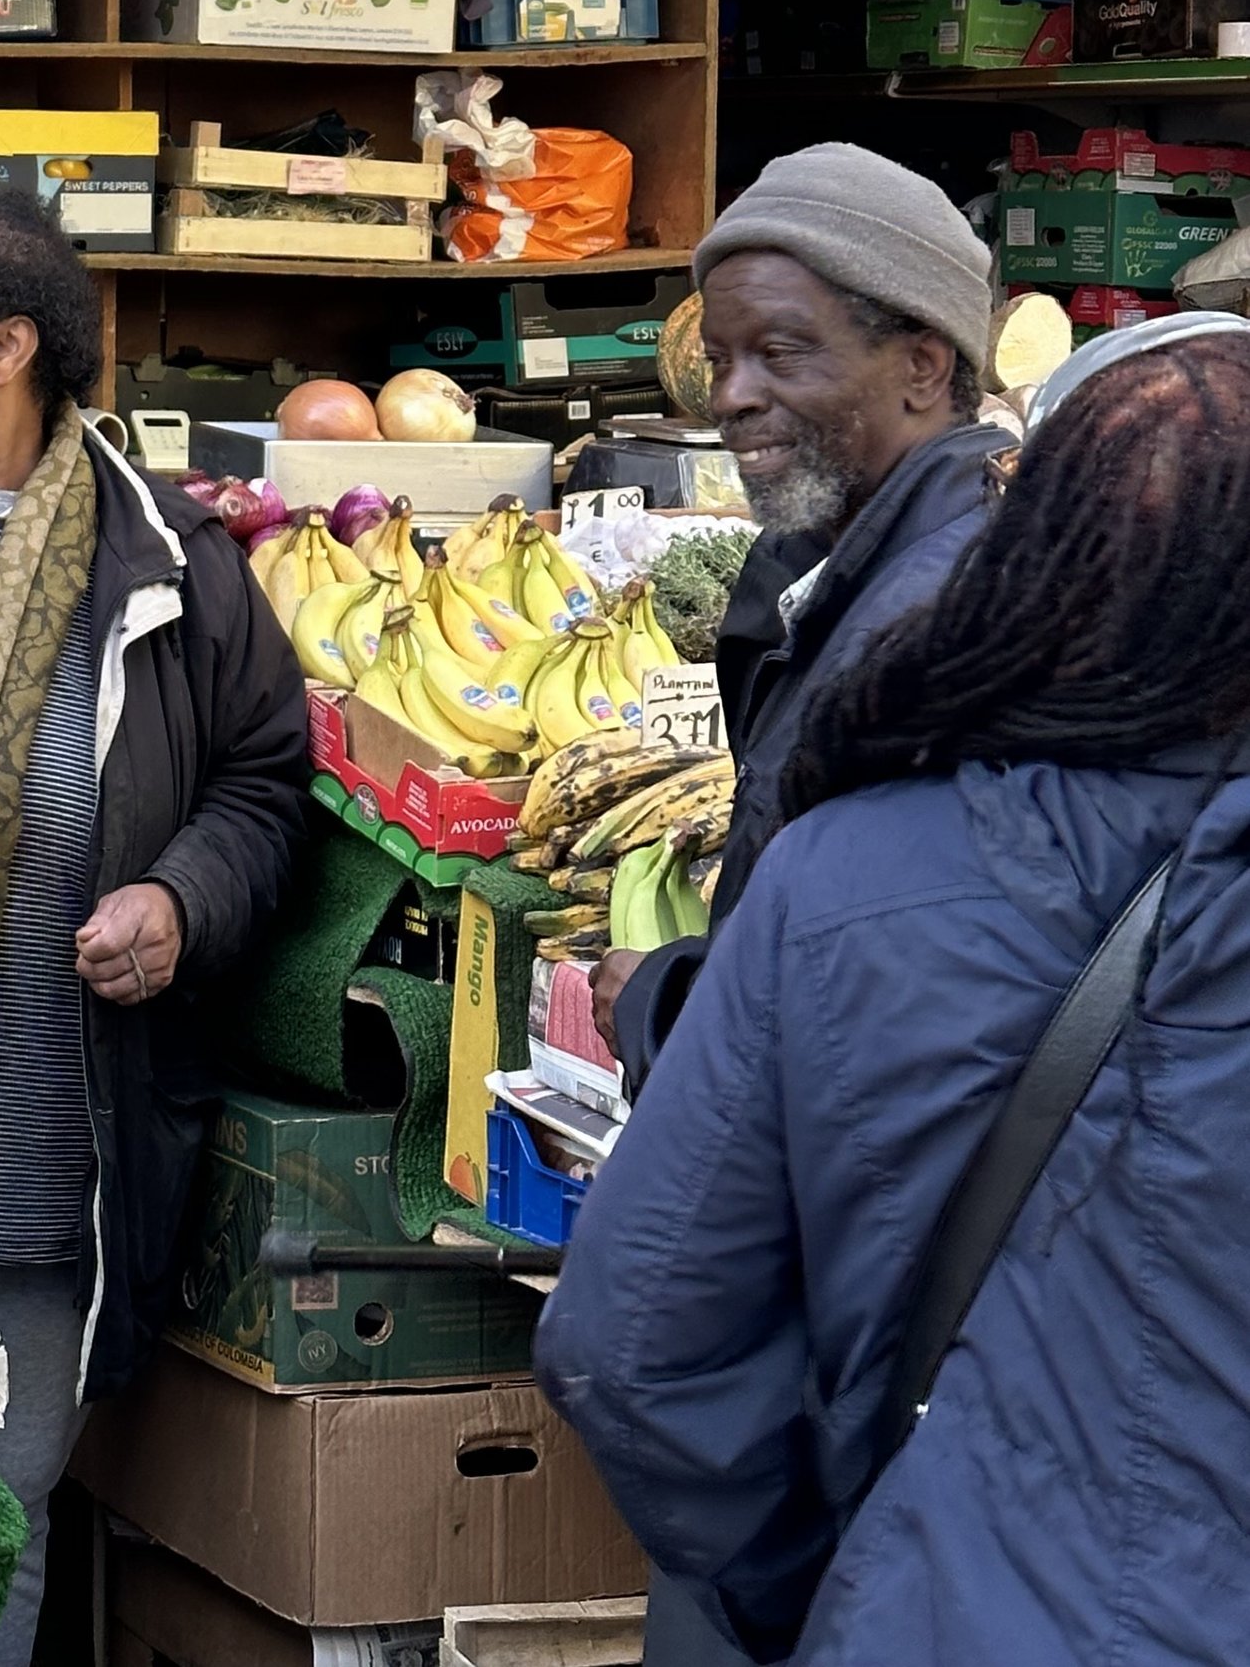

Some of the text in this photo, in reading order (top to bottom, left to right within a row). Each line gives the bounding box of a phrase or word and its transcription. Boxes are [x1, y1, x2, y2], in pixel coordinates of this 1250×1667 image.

[64, 180, 149, 192] SWEET PEPPERS
[436, 332, 465, 352] ESLY
[469, 913, 490, 1009] Mango
[217, 1337, 264, 1375] COLOMBIA
[307, 1342, 327, 1360] IVY
